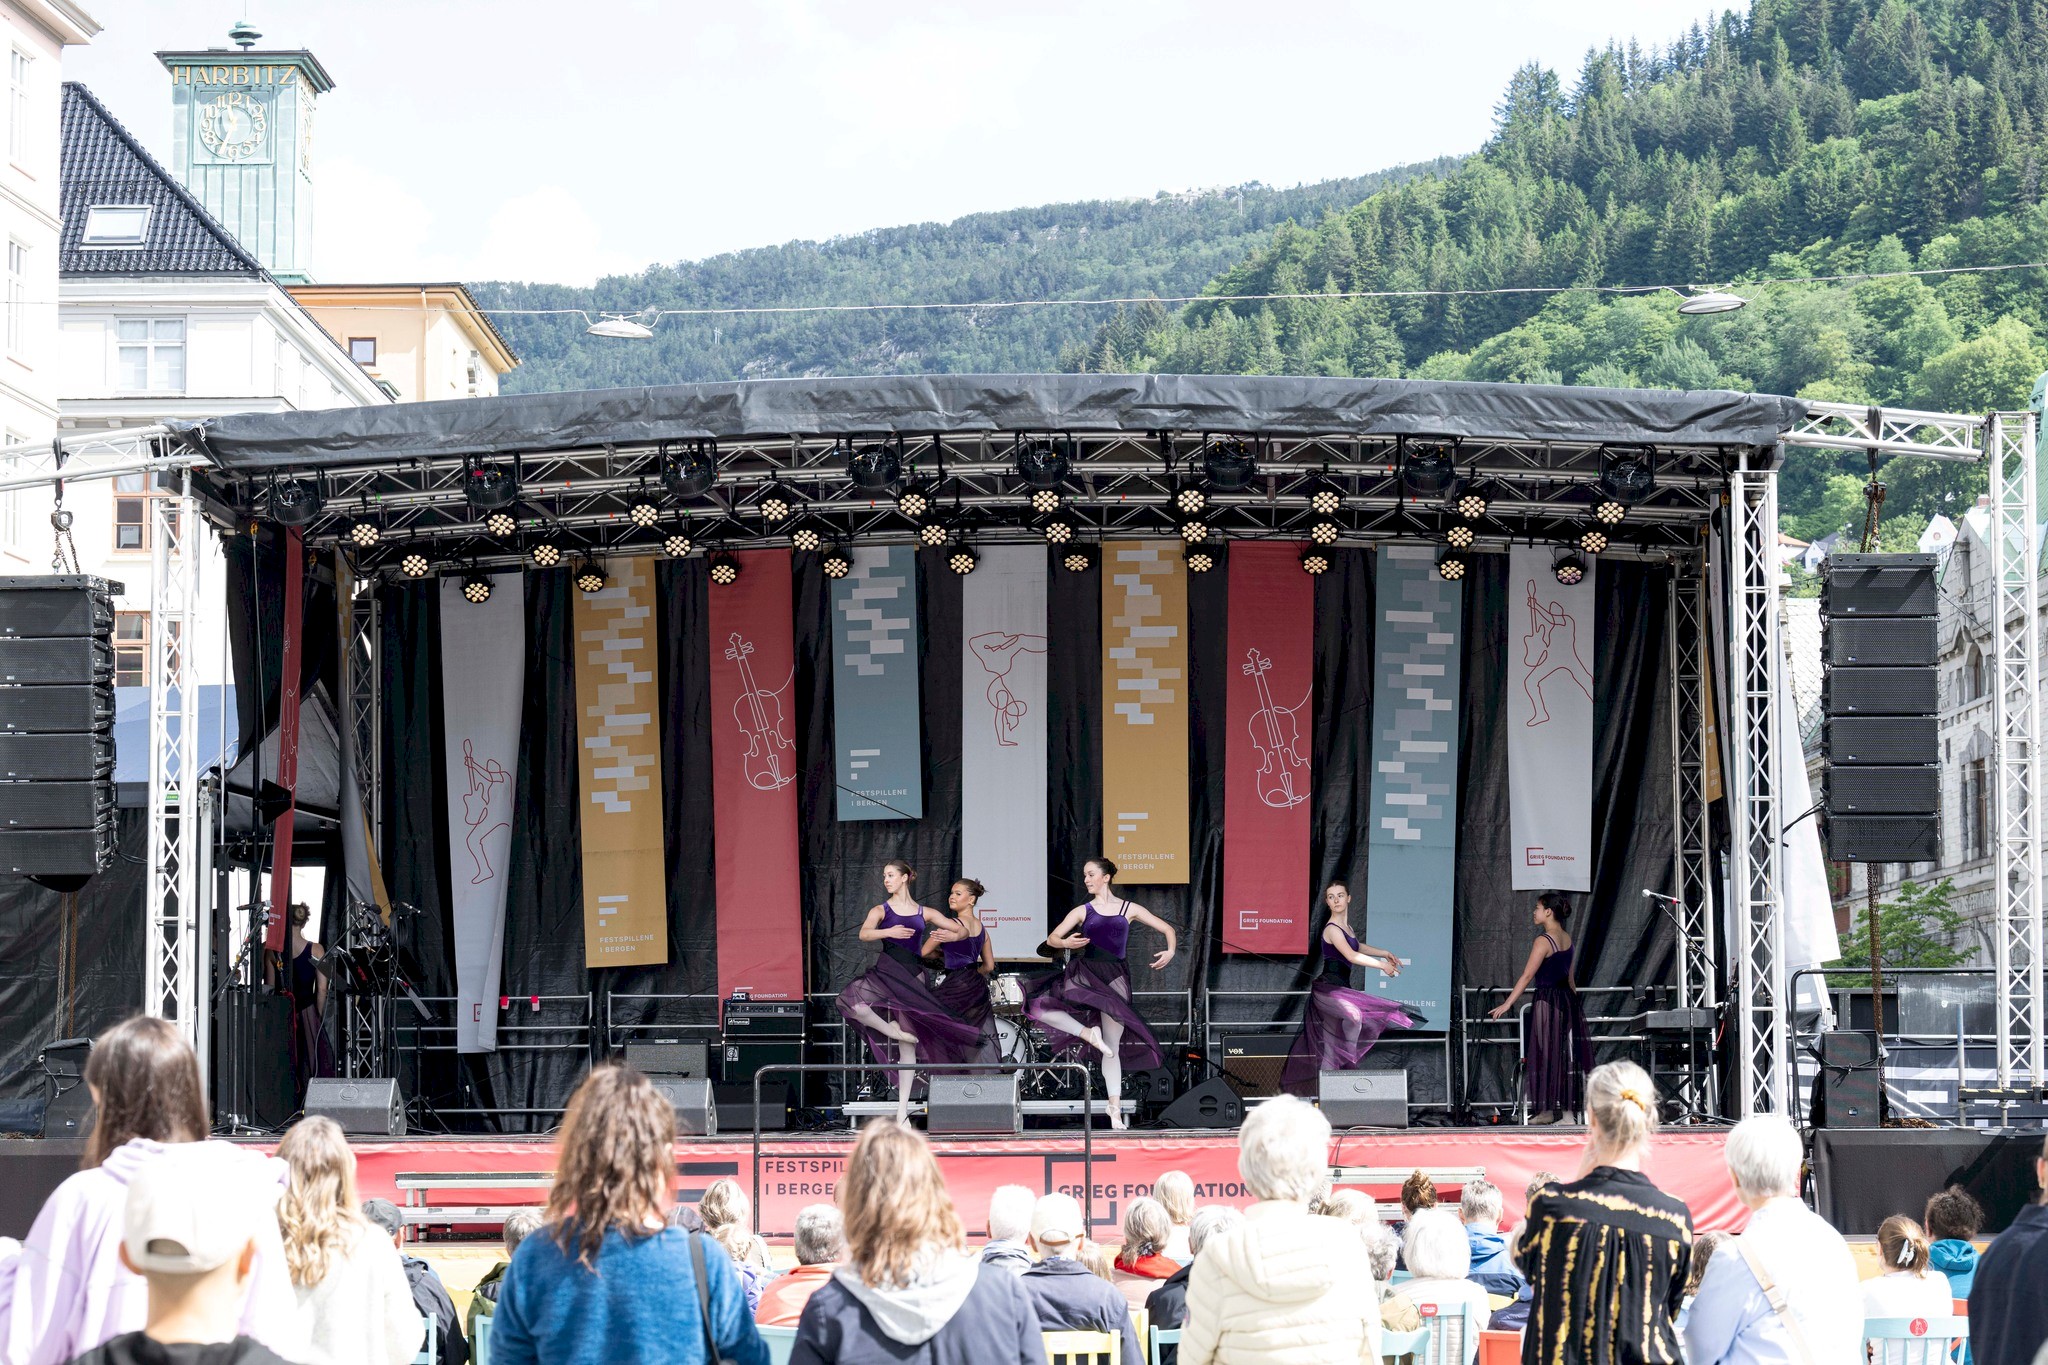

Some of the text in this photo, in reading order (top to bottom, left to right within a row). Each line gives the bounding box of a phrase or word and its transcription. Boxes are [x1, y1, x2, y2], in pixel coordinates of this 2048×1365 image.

[173, 65, 296, 86] HARBITZ
[600, 934, 654, 943] FESTSPILLENE
[605, 945, 636, 953] BERGEN
[765, 1182, 834, 1195] I BERGE
[1058, 1184, 1117, 1199] GREG
